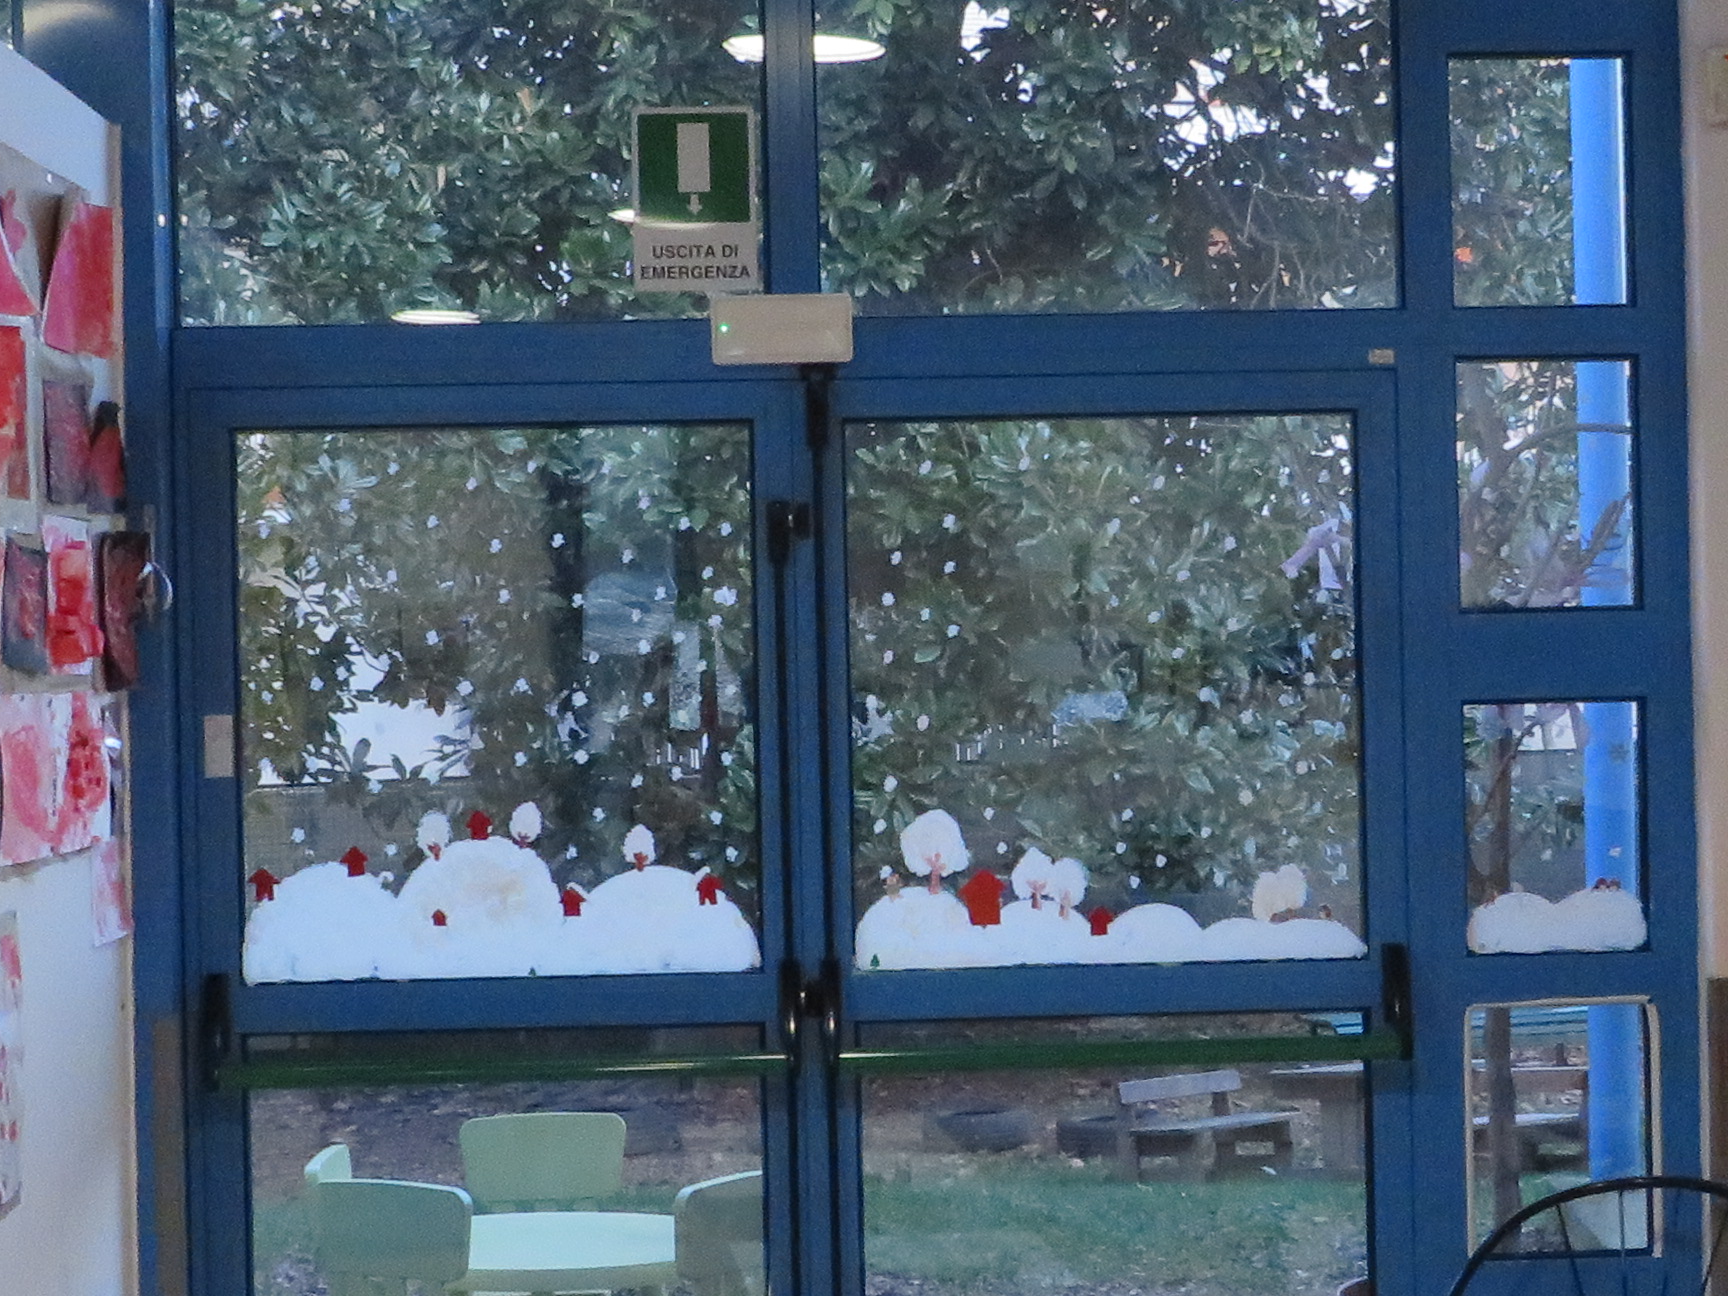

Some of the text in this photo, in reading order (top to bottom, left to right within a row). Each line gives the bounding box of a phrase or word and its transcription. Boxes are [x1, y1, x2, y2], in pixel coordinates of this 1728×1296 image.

[652, 244, 738, 259] USCITA DI
[640, 265, 751, 280] EMERGENZA
